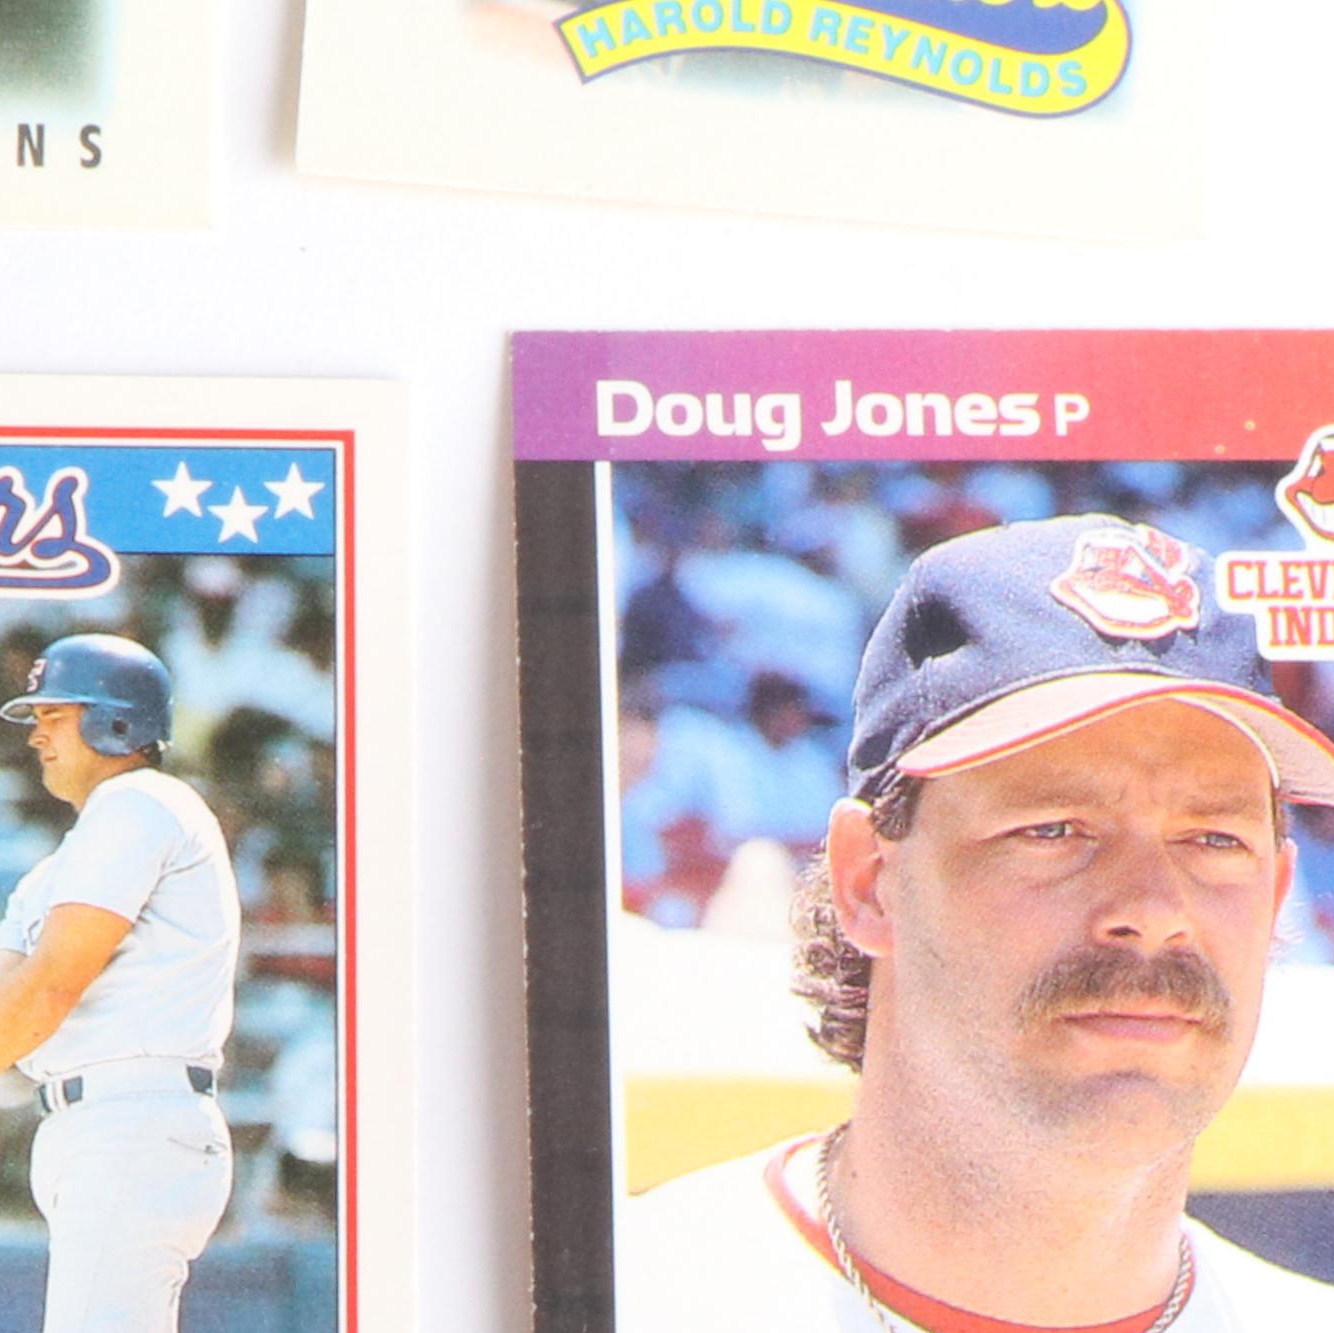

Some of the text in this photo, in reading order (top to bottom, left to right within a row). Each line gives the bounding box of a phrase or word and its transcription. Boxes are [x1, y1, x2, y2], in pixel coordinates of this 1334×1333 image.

[576, 0, 1088, 97] HAROLD REYNOLDS
[595, 379, 1091, 452] Doug Jones P
